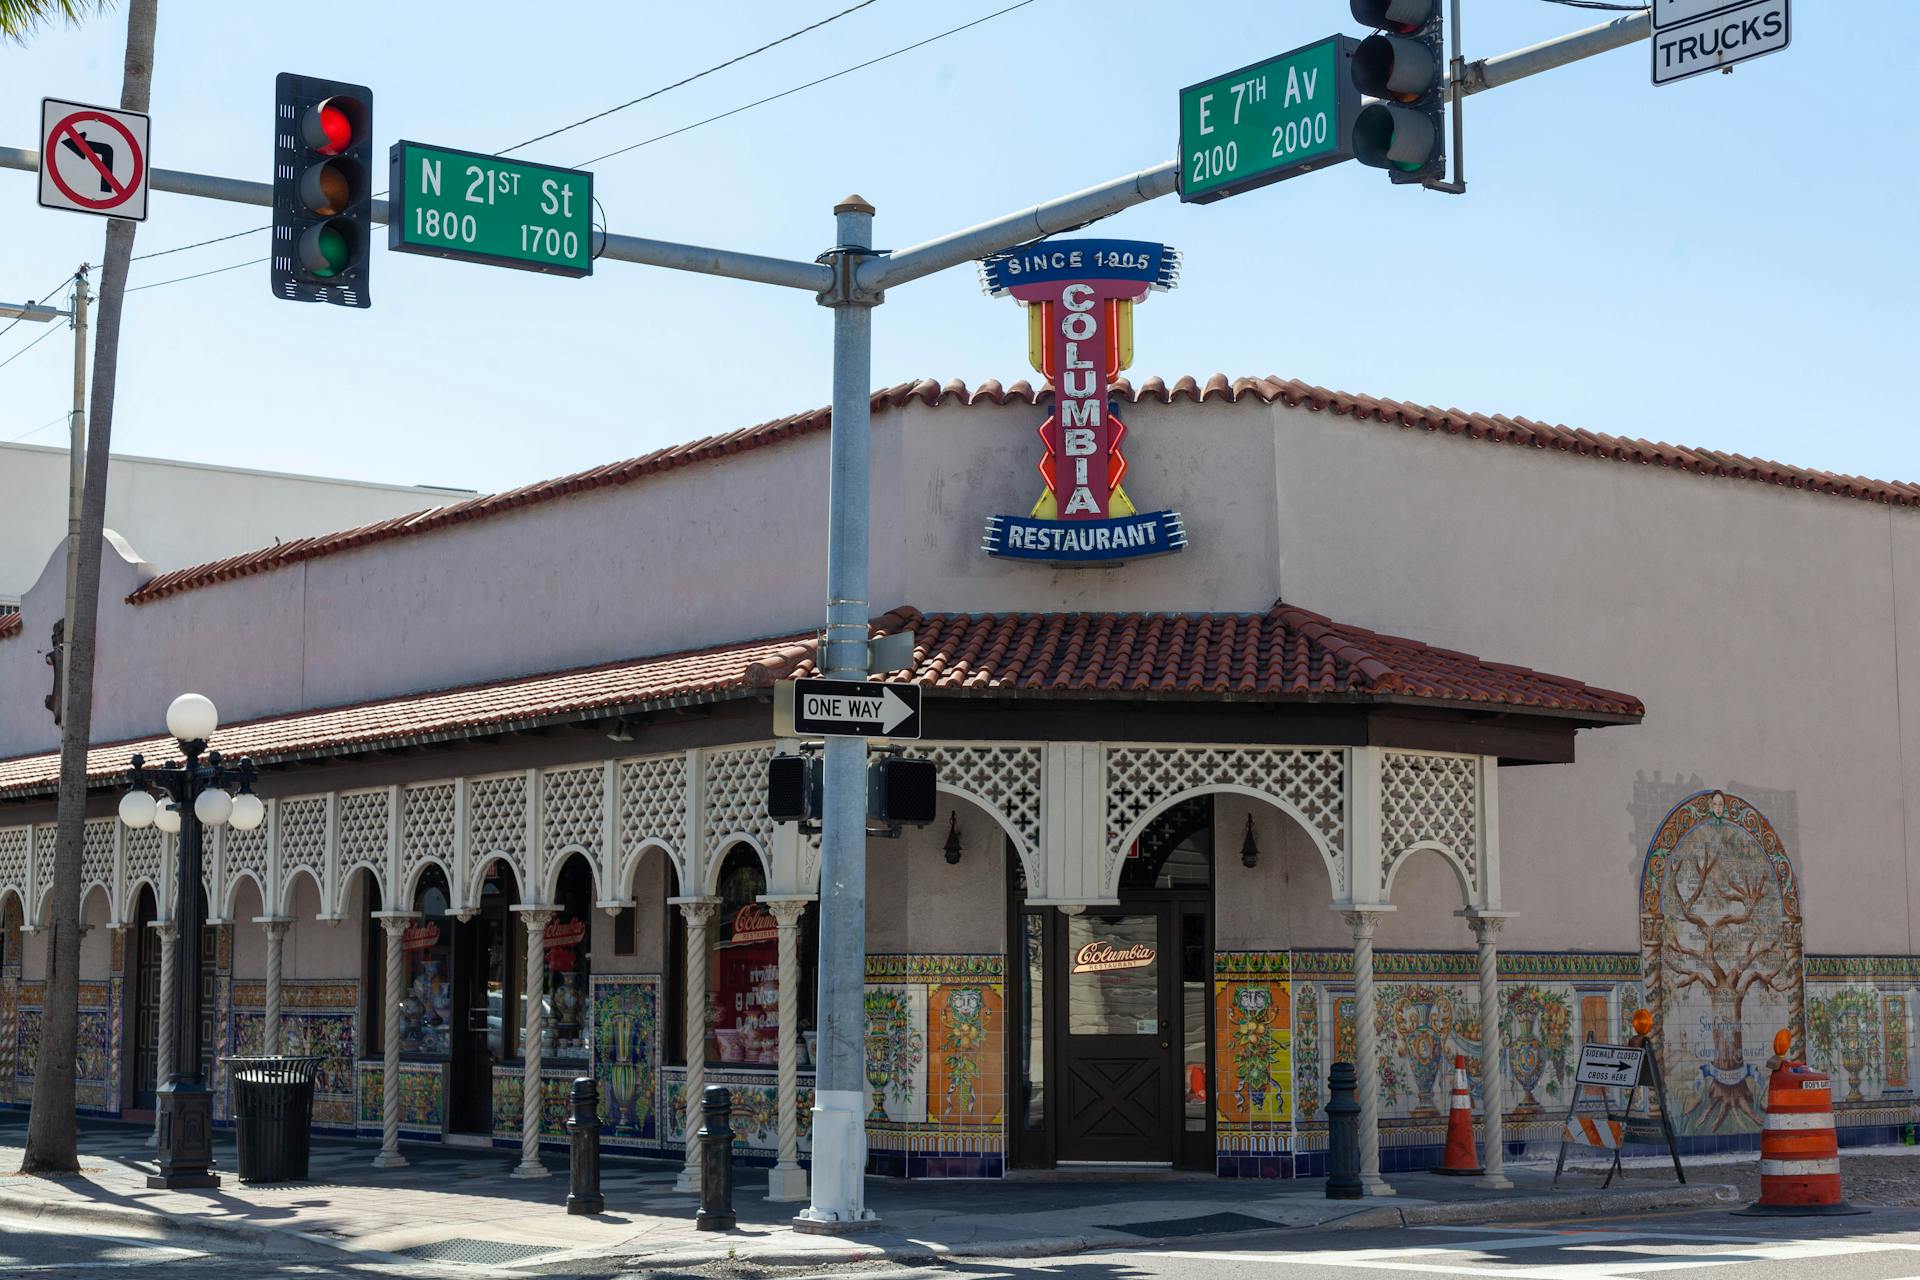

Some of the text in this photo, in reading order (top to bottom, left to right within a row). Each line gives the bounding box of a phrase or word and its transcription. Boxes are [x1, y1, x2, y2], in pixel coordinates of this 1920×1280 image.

[1659, 11, 1782, 67] TRUCKS
[1199, 65, 1318, 136] E 7TH Av
[1271, 112, 1327, 158] 2000
[1192, 140, 1238, 183] 2100
[422, 158, 574, 218] N 21ST St
[416, 207, 477, 243] 1800
[521, 224, 578, 259] 1700
[1008, 251, 1151, 275] SINCE 1905
[1061, 284, 1101, 515] COLUMBIA
[1008, 521, 1158, 552] RESTAURANT
[808, 698, 883, 718] ONE WAY
[735, 903, 777, 932] Colum
[1077, 940, 1155, 964] Columbia
[1089, 961, 1137, 970] RESTAURANT
[1585, 1049, 1639, 1060] SIDEWALK CLOSED
[1588, 1071, 1628, 1082] CROSS HERE
